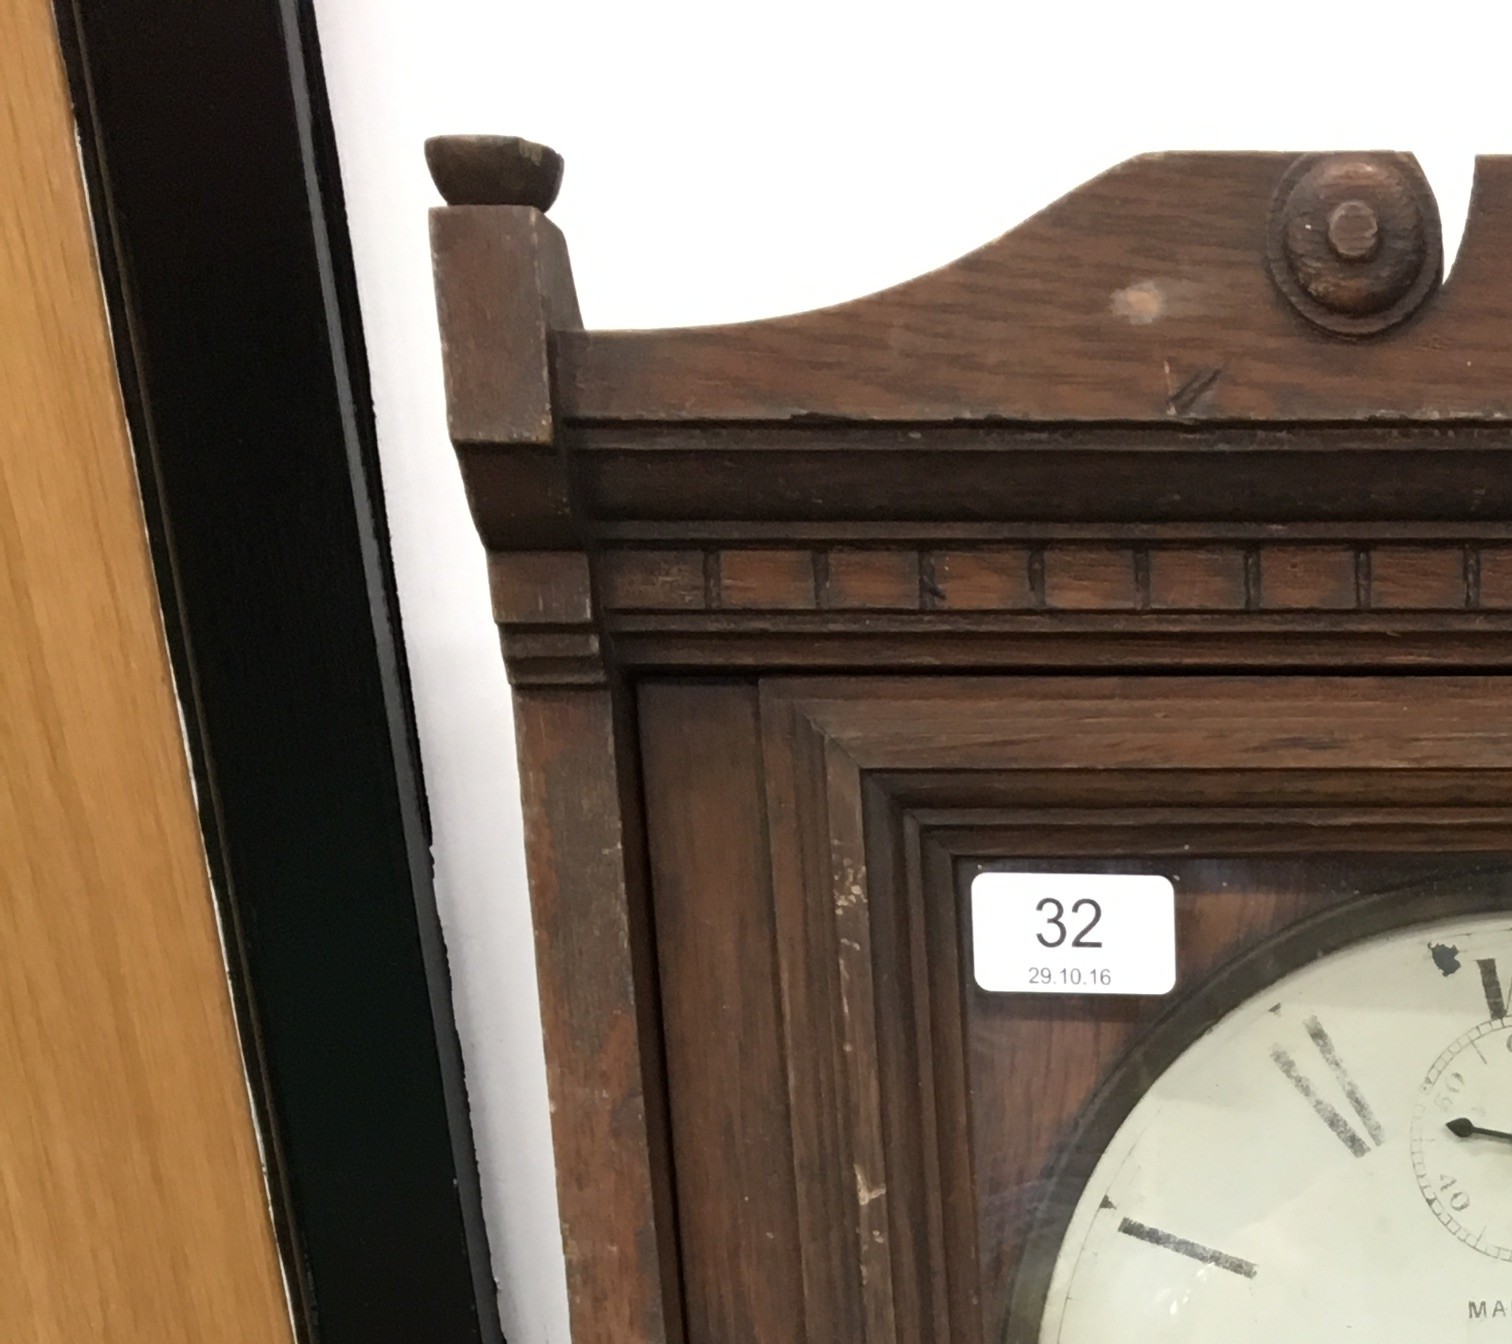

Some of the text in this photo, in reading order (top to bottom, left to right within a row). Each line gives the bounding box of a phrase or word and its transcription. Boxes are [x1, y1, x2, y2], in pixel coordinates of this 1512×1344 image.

[1036, 897, 1103, 949] 32
[1027, 966, 1112, 987] 29.10.16
[1439, 1173, 1471, 1212] 40
